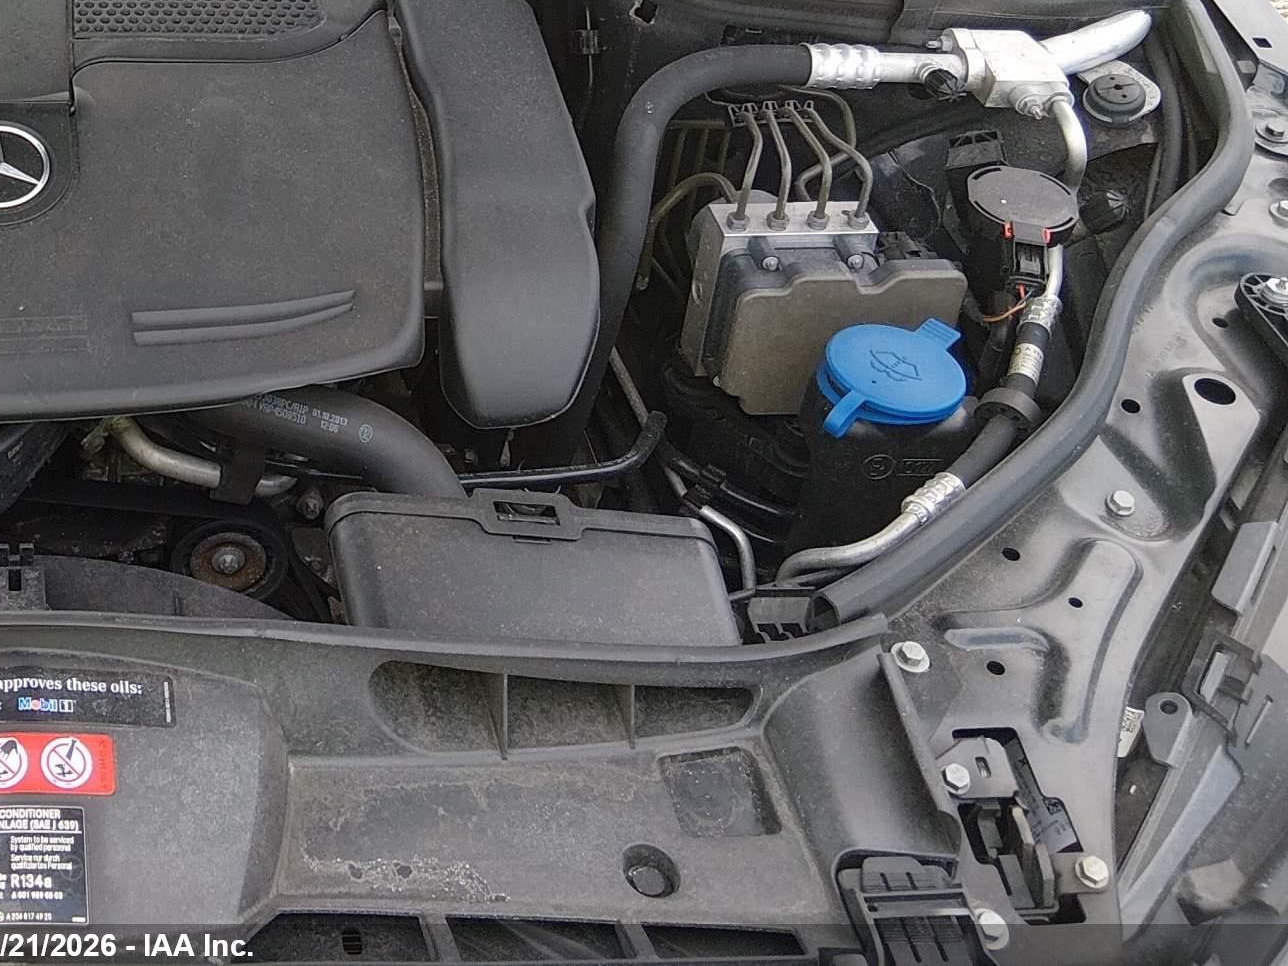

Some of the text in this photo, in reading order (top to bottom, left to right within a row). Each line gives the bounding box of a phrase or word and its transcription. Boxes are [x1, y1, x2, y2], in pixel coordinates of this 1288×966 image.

[66, 677, 107, 692] these
[111, 680, 143, 694] oils:
[18, 697, 57, 712] Mobil
[29, 819, 51, 831] (SAE
[10, 873, 52, 889] R134a
